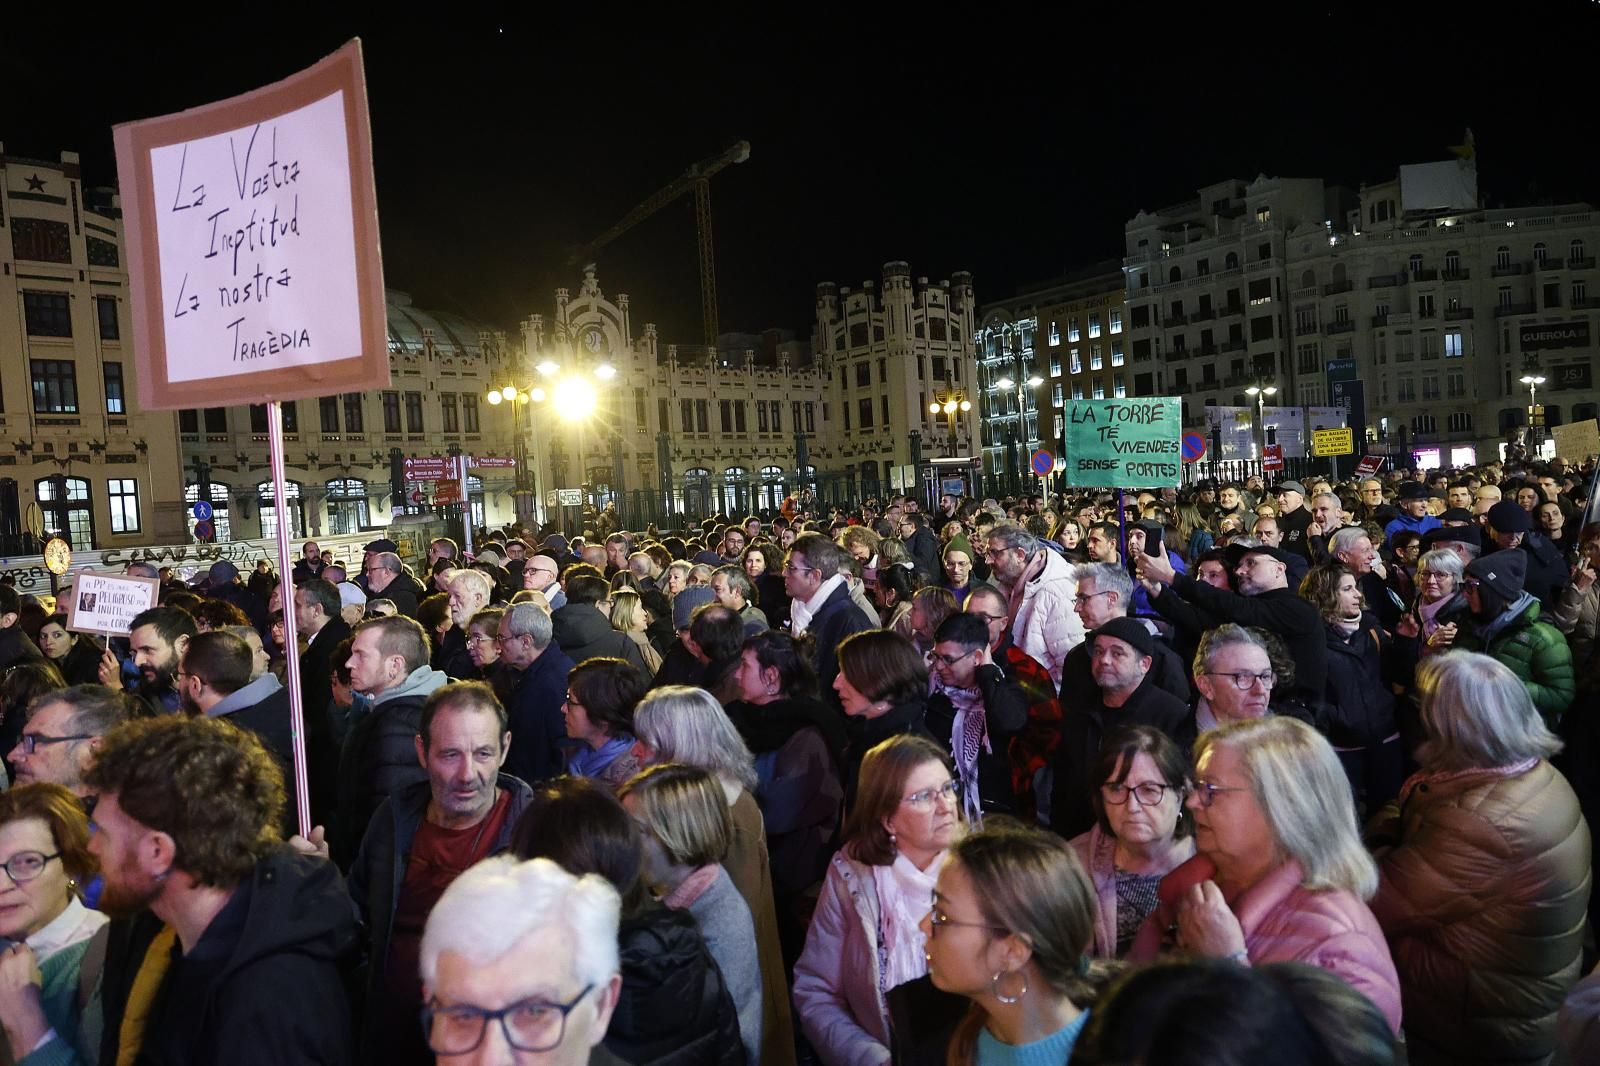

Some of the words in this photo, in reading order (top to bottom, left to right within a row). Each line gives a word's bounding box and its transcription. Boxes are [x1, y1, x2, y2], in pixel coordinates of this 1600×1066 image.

[173, 144, 206, 212] La
[230, 123, 300, 200] Vostra
[205, 193, 300, 276] Ineptitud
[174, 272, 200, 318] La
[218, 263, 291, 307] nostra
[1522, 329, 1577, 342] GUEROLA
[1071, 405, 1096, 424] LA
[1104, 403, 1165, 424] TORRE
[1096, 424, 1120, 442] TÉ
[1111, 440, 1179, 454] VIVENDES
[1078, 459, 1120, 471] SENSE
[1125, 462, 1177, 478] PORTES
[93, 579, 106, 589] PP
[98, 591, 136, 606] PELIGROSO
